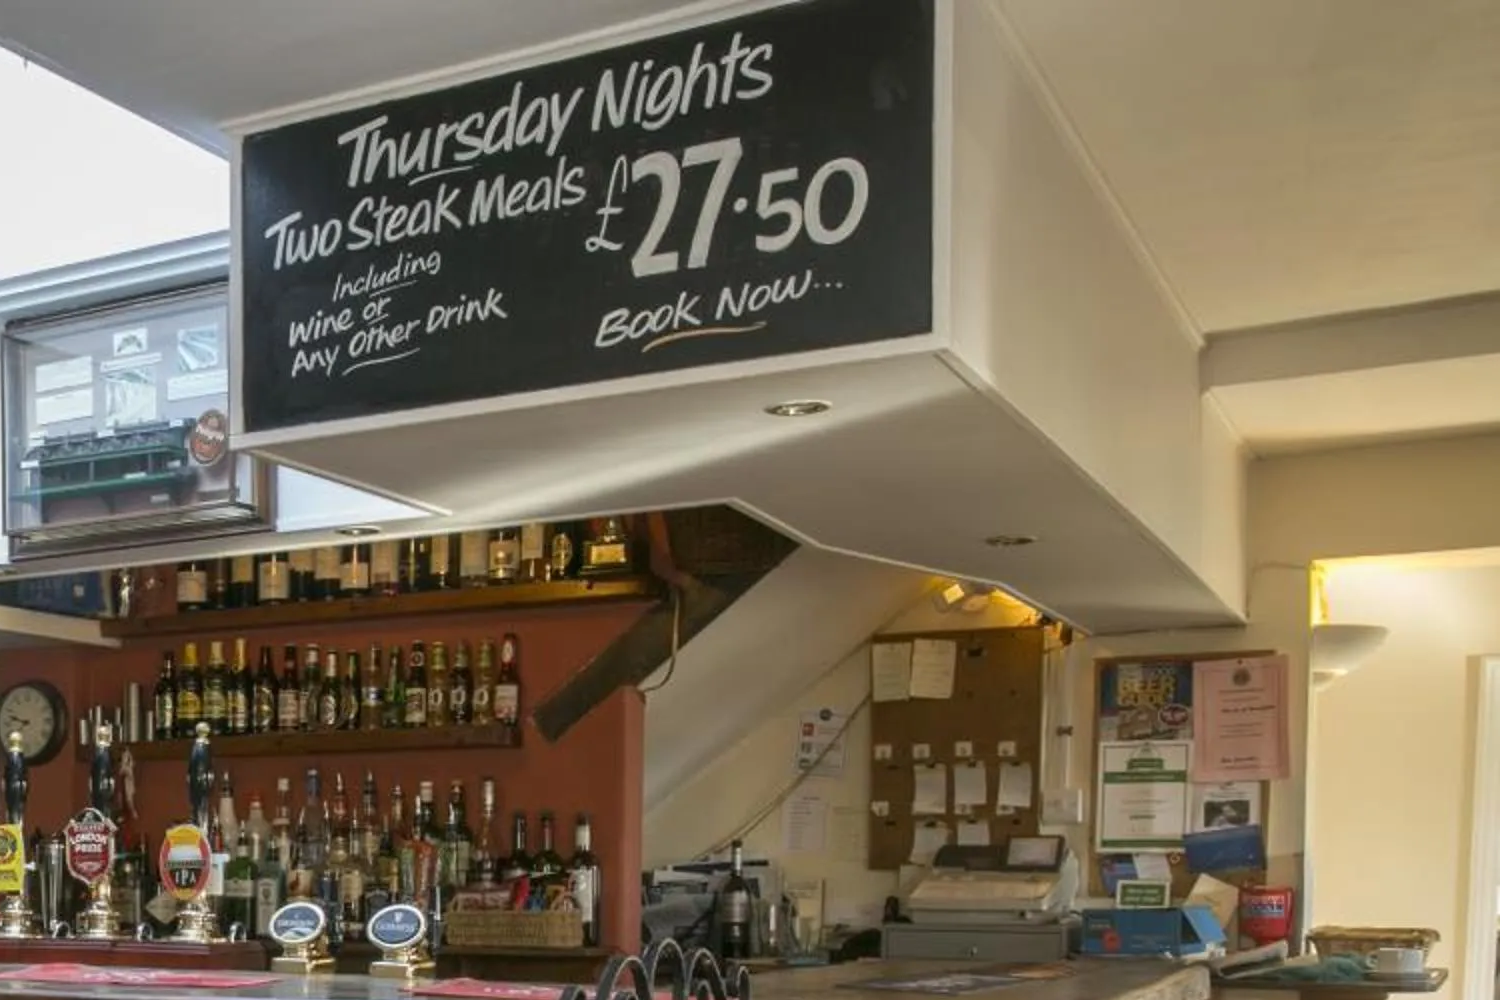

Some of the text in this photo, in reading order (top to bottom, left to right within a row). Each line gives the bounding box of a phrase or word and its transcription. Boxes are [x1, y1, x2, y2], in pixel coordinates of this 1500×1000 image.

[338, 31, 773, 188] Thursday Nights
[265, 156, 587, 271] Two Steak Meals
[332, 250, 442, 302] Including
[289, 297, 392, 348] Wine or
[291, 287, 508, 379] Any Other Drink
